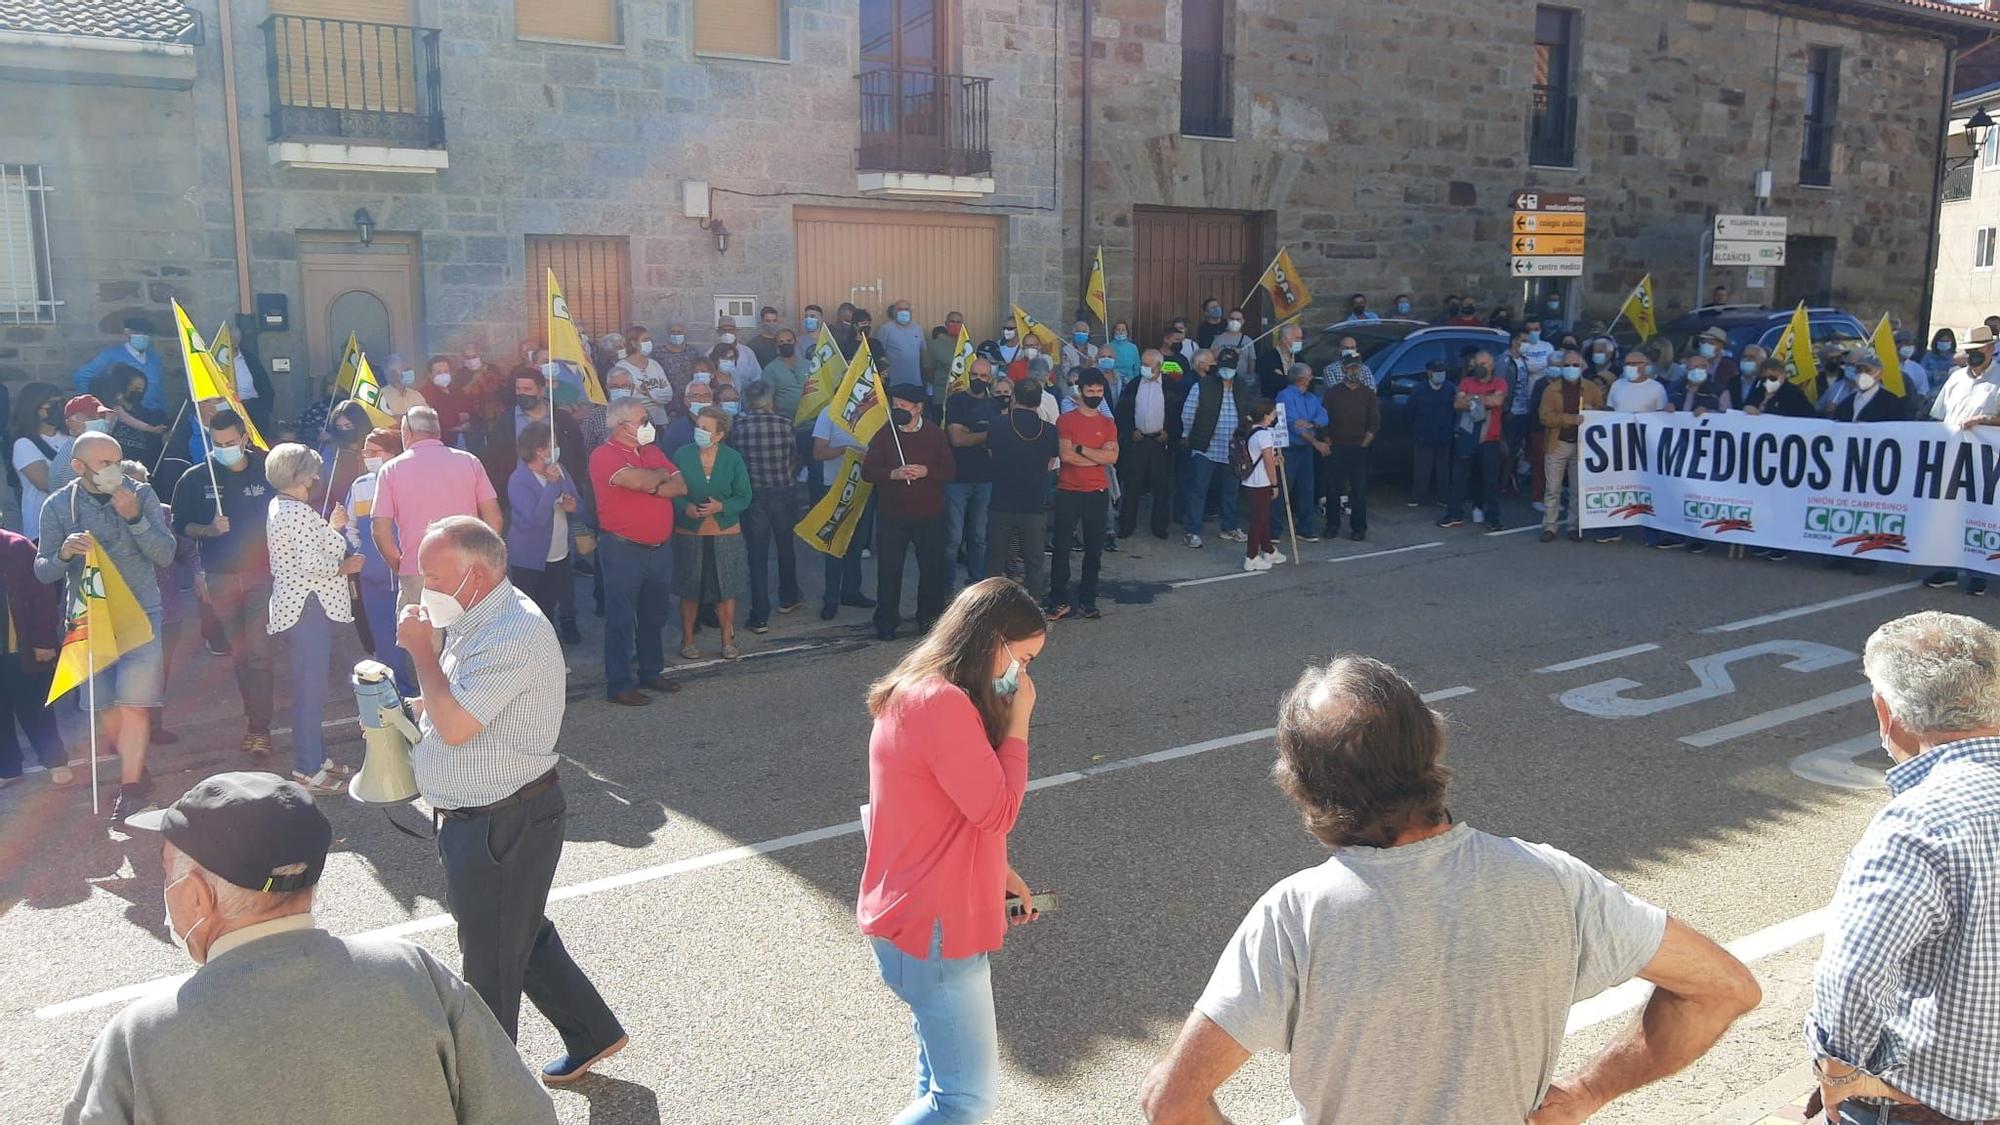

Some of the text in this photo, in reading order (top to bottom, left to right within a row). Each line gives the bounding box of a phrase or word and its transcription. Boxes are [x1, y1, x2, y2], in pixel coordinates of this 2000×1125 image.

[1714, 251, 1751, 262] ALCAÑICES
[1537, 262, 1559, 271] centro
[1585, 419, 2000, 505] SIN MÉDICOS NO HAY
[1586, 491, 1652, 509] COAG
[1807, 496, 1909, 512] UNIÓN DE CAMPESINOS
[1684, 501, 1752, 521] COAG
[1806, 508, 1904, 535] COAG
[1803, 532, 1832, 541] ZAMORA
